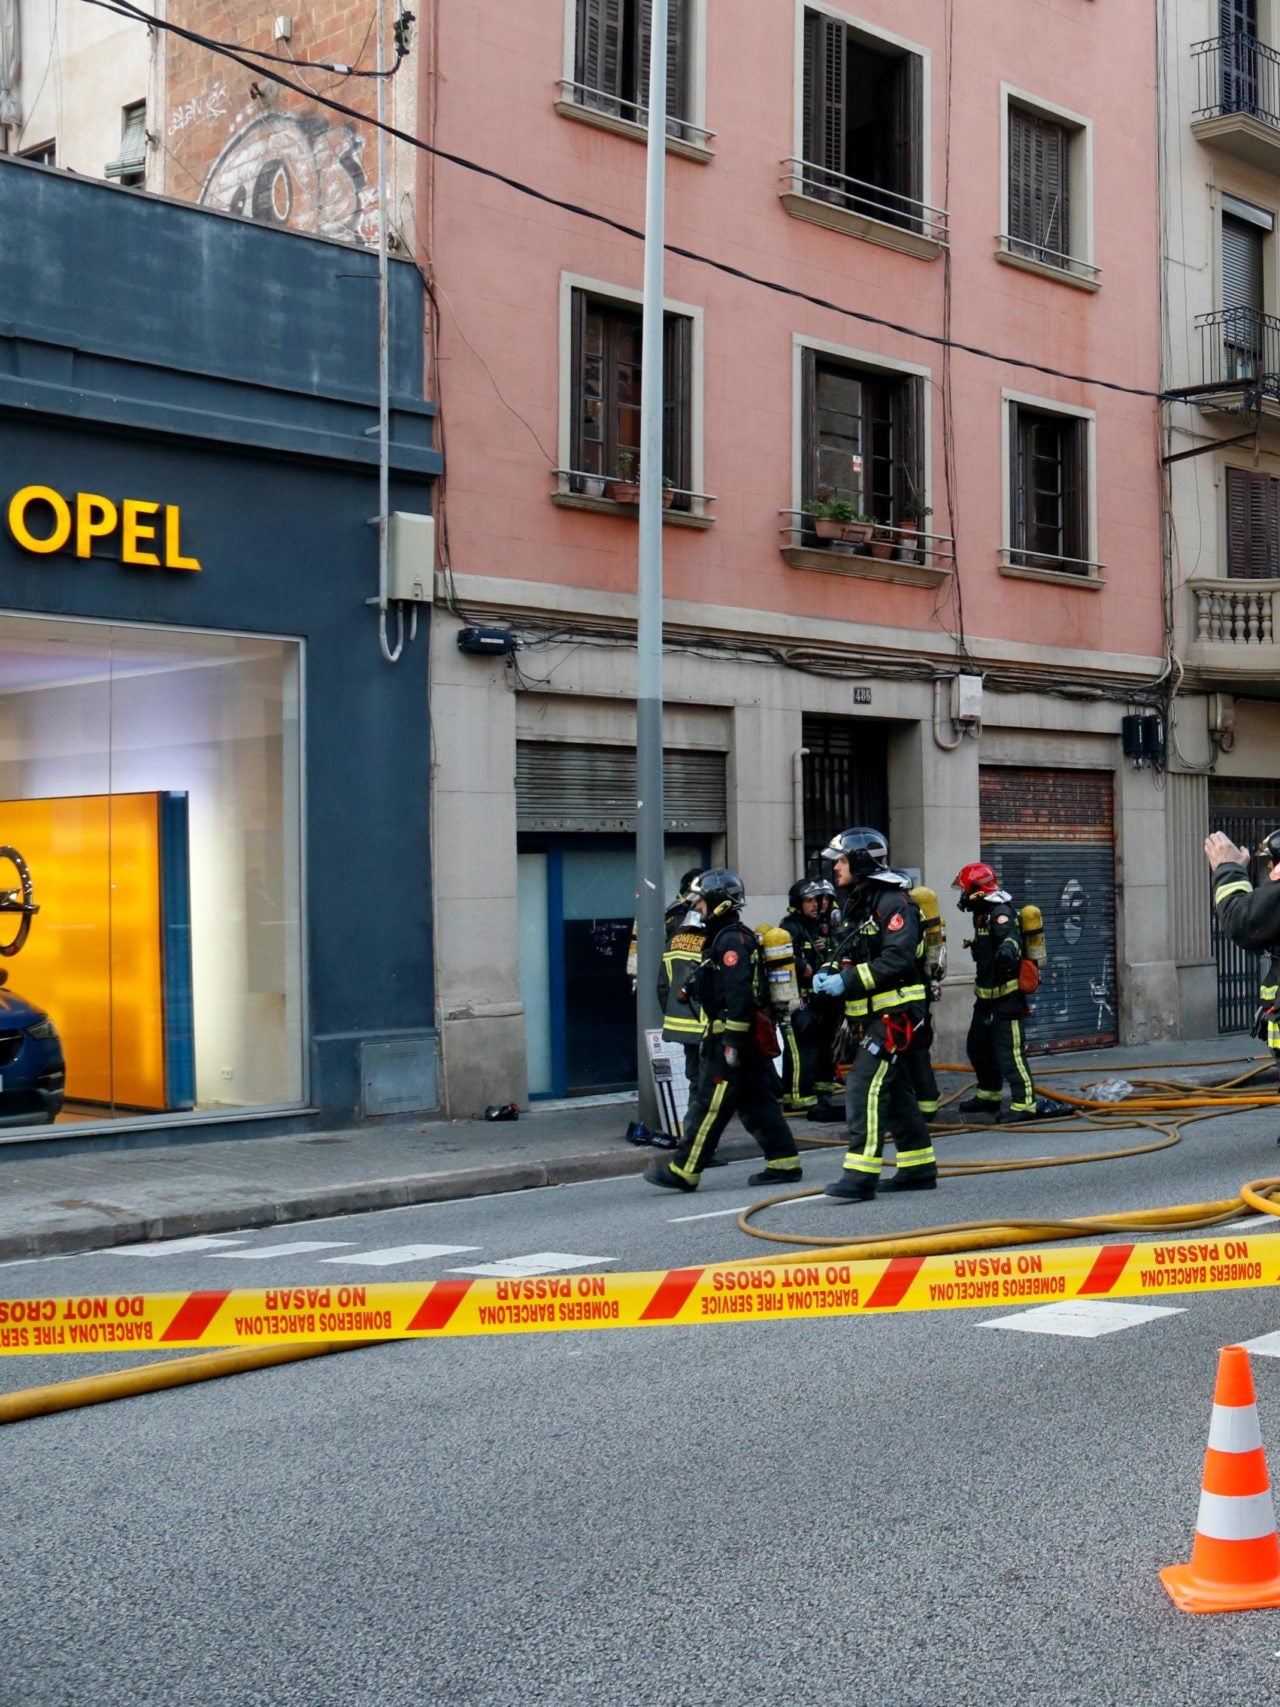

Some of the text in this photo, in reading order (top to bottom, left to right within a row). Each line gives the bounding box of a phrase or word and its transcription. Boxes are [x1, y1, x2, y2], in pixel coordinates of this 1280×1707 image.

[8, 485, 202, 571] OPEL
[855, 688, 871, 702] 486
[671, 933, 705, 946] BOMBER
[1154, 1241, 1248, 1265] NO PASSAR
[954, 1255, 1042, 1278] NO PASAR
[1141, 1262, 1261, 1287] BOMBERS BARCELONA
[497, 1277, 605, 1301] NO PASSAR
[713, 1266, 850, 1292] DO NOT CROSS
[929, 1275, 1065, 1301] BOMBEROS BARCELONA
[62, 1297, 108, 1321] NOT
[115, 1296, 144, 1318] DO
[265, 1287, 366, 1311] NO PASAR
[702, 1288, 858, 1315] BARCELONA FIRE SERVICE
[235, 1310, 391, 1336] BOMBEROS BARCELONA
[479, 1300, 619, 1325] BOMBERS BARCELONA
[0, 1320, 153, 1348] BARCELONA FIRE SER
